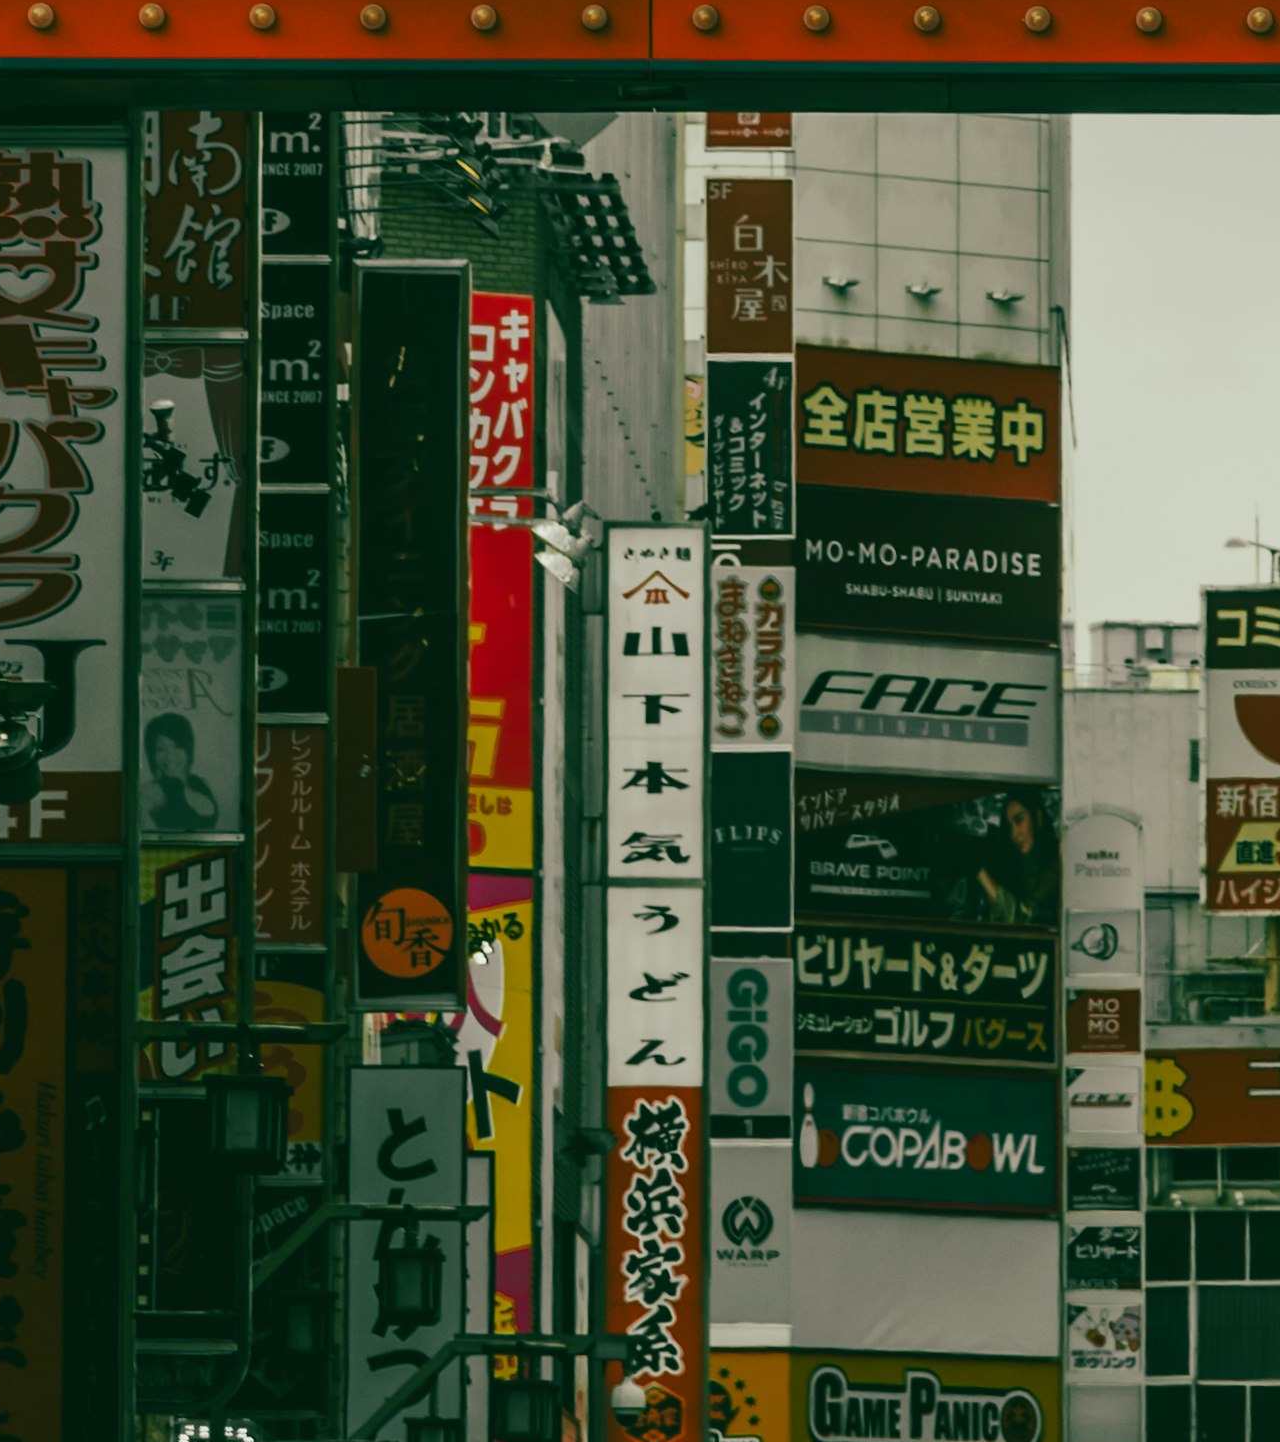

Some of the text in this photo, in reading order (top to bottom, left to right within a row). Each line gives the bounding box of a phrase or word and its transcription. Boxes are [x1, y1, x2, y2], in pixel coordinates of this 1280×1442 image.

[803, 385, 1047, 464] 全店営業中
[804, 538, 1043, 577] MO-MO-PARADISE
[845, 582, 1004, 607] SHABU-SHABU SUKIYAKI
[714, 576, 751, 739] まねきねこ
[754, 602, 785, 717] カラオケ
[802, 670, 1048, 721] FACE
[289, 730, 313, 932] レンタルルーム ホステル
[810, 860, 932, 882] BRAVE POINT
[794, 934, 1049, 1000] ビリヤード&ダーツ
[1087, 997, 1121, 1014] MO
[1087, 1017, 1121, 1036] MO
[873, 1007, 957, 1051] ゴルフ
[961, 1016, 1049, 1054] バグース
[716, 1248, 781, 1262] WARP
[810, 1366, 901, 1440] GAME
